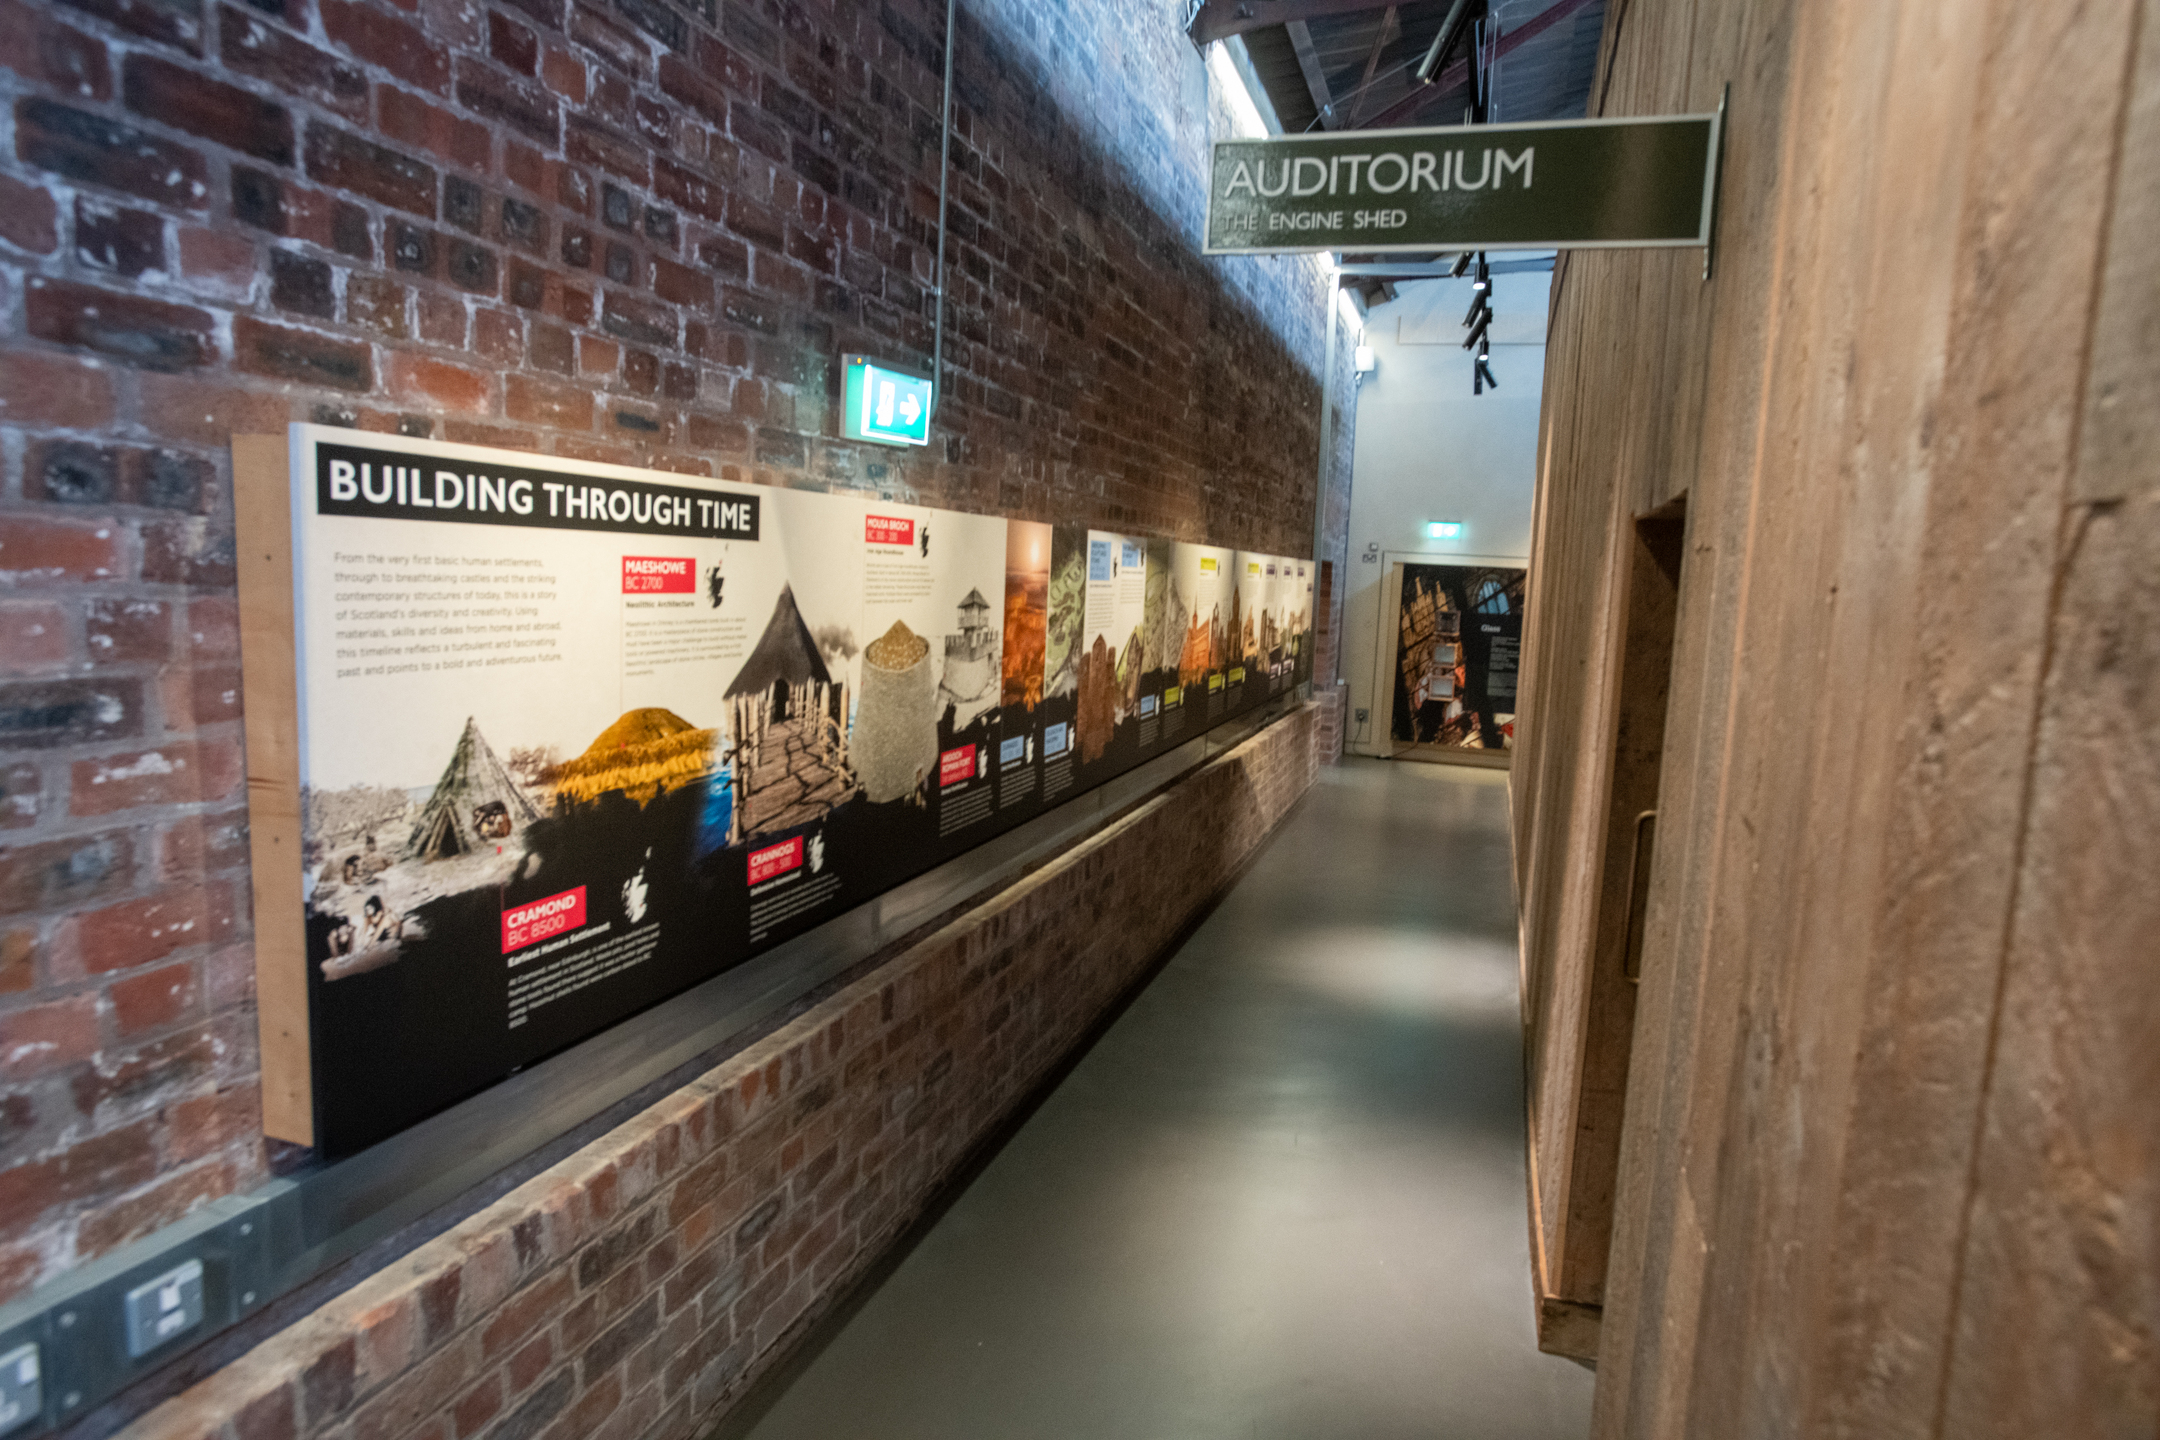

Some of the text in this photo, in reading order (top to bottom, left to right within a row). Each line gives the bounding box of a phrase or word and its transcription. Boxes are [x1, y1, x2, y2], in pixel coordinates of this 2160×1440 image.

[1224, 147, 1535, 198] AUDITORIUM
[1223, 209, 1408, 231] THE ENGINE SHED
[329, 459, 752, 531] BUILDING THROUGH TIME
[625, 560, 686, 574] MAESHOWE
[625, 576, 664, 590] BC 2700
[507, 894, 576, 928] CRAMOND
[507, 914, 566, 946] BC 8500
[507, 921, 610, 967] Earliest Human Settlement
